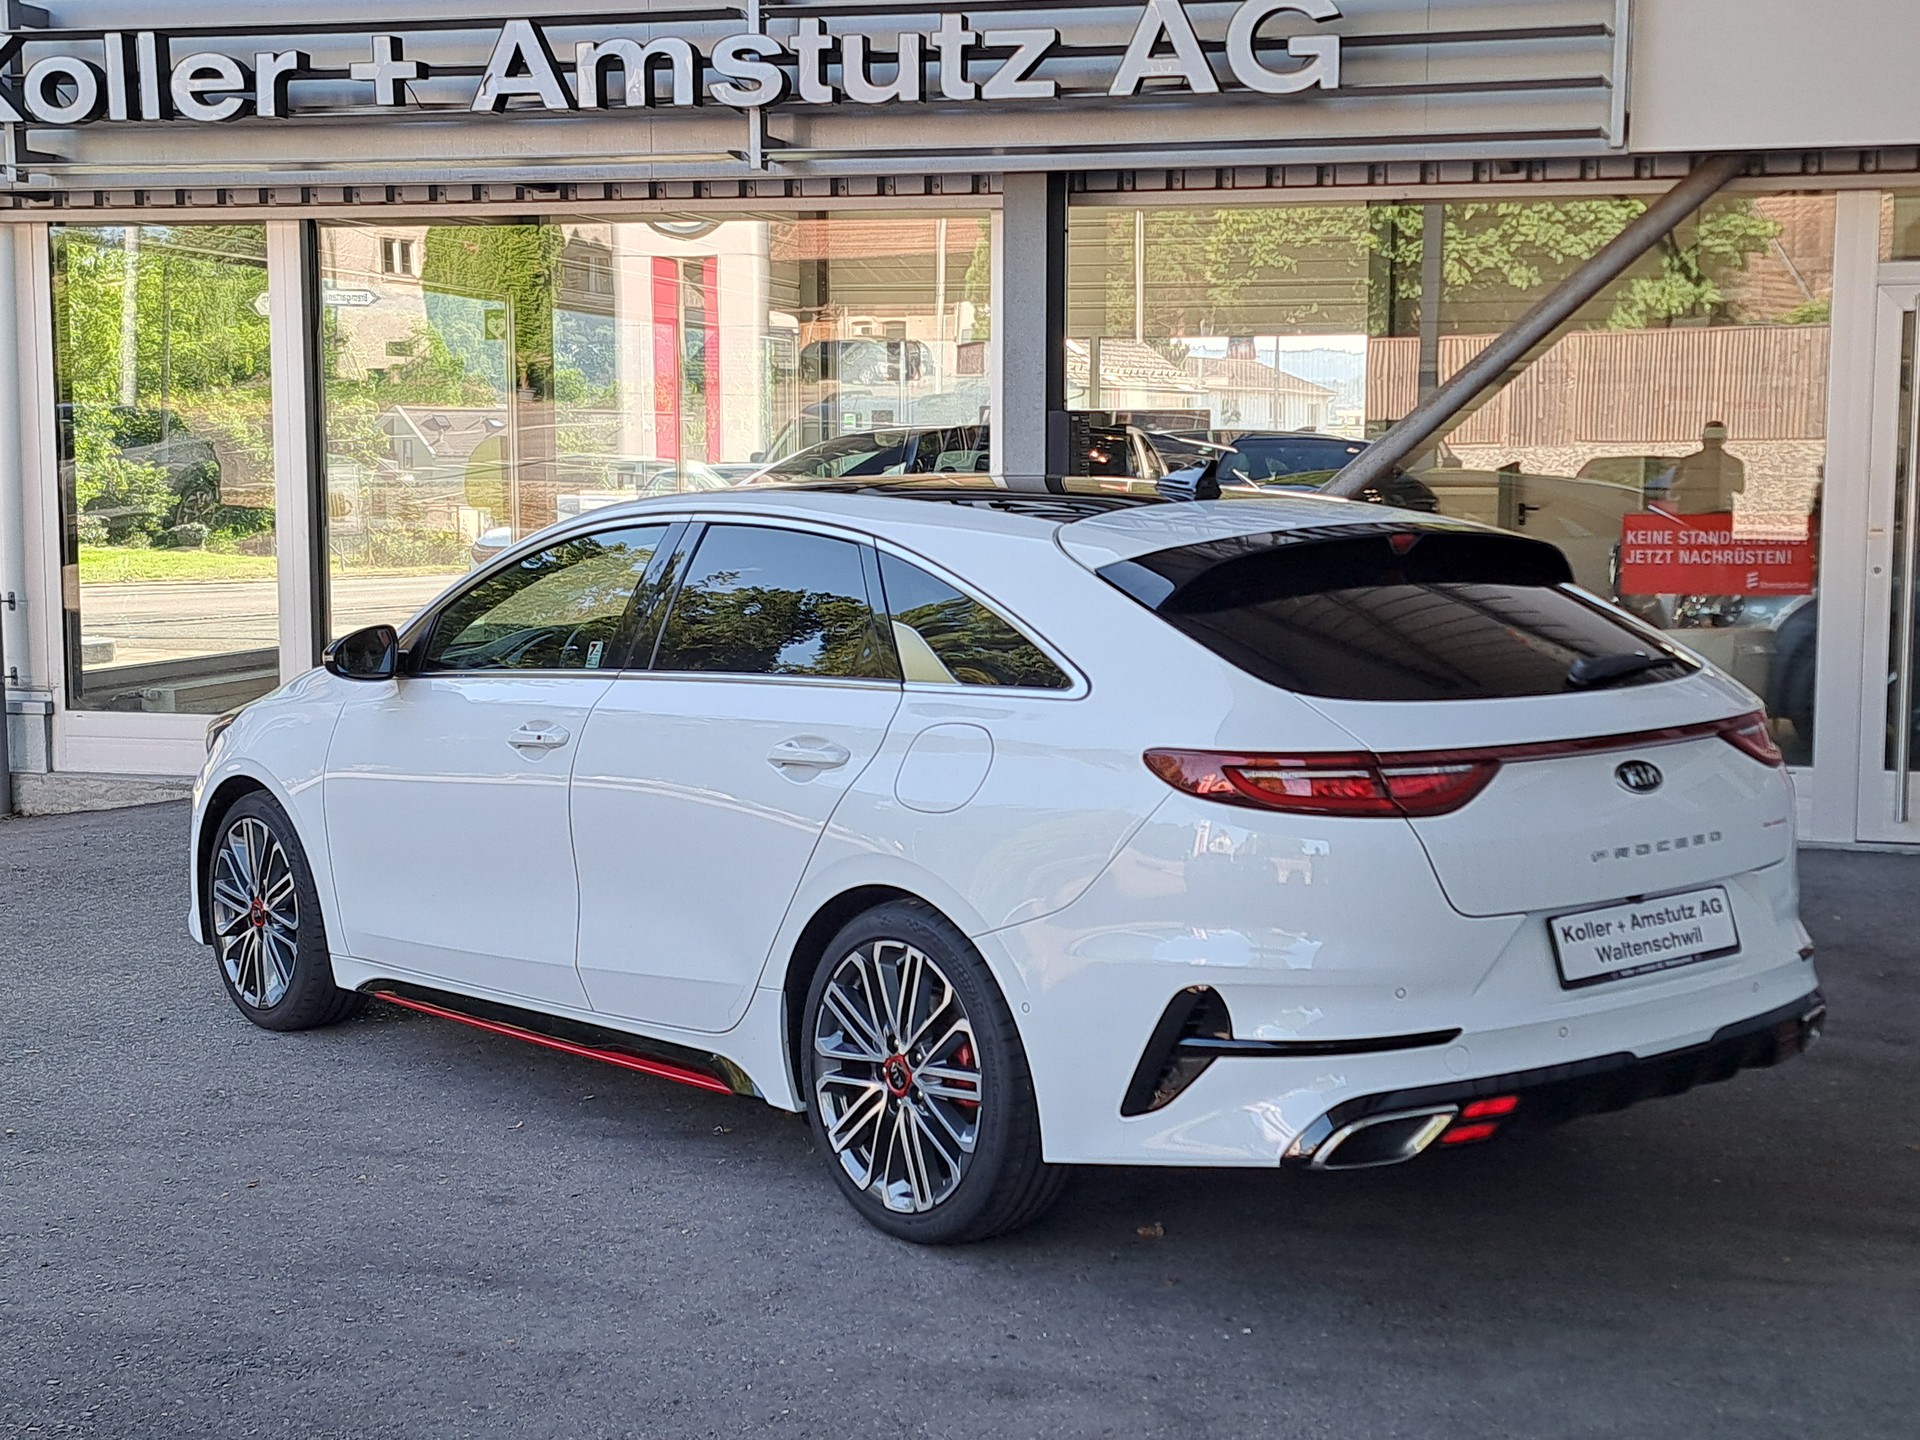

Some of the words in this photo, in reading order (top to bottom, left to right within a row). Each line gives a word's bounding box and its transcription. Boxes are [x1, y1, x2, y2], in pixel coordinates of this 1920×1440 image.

[471, 13, 1058, 113] Amstutz
[1108, 0, 1342, 98] AG
[1626, 530, 1674, 546] KEINE
[1626, 549, 1673, 565] JETZT
[1678, 547, 1793, 565] NACHRÜSTEN!
[1621, 763, 1661, 788] KIA
[1561, 921, 1613, 943] Koller
[1630, 904, 1697, 930] Amstutz
[1700, 898, 1724, 917] AG
[1594, 927, 1703, 964] Waltenschwil
